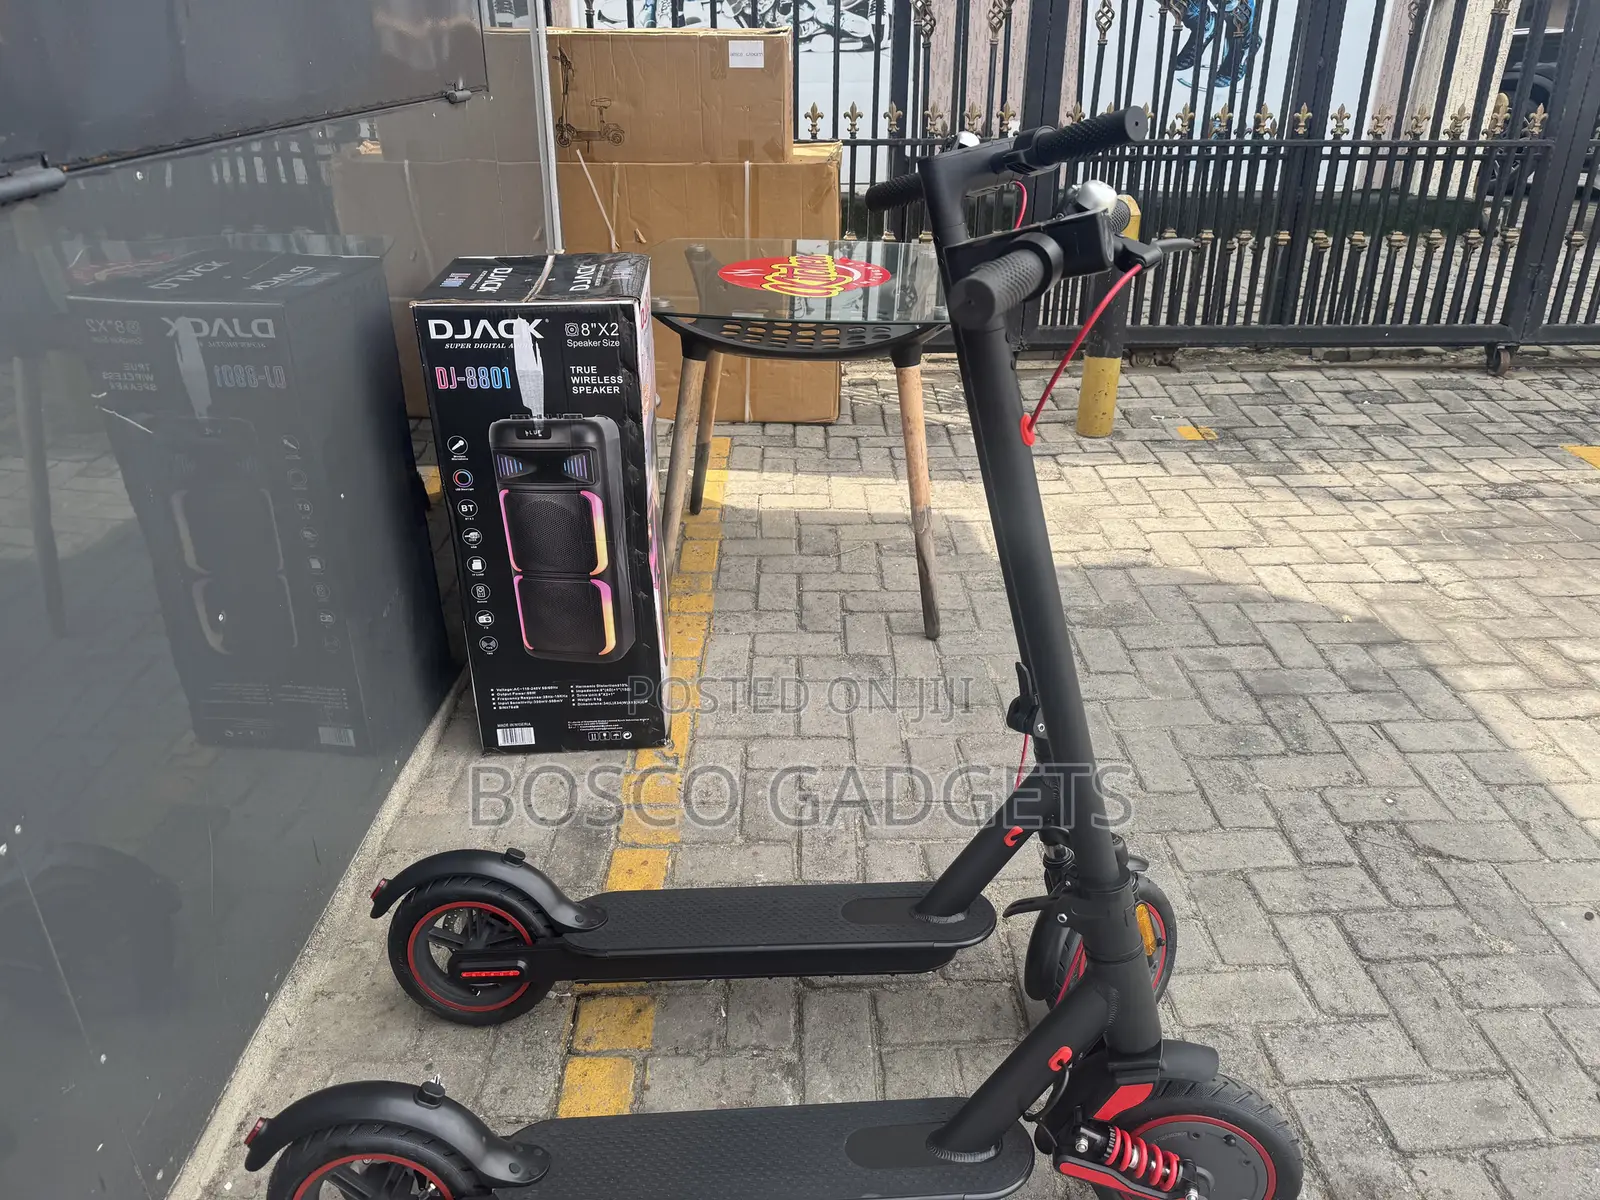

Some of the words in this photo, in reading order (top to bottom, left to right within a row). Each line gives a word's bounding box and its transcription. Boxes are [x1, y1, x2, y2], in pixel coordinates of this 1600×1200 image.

[581, 322, 620, 336] 8"X2
[567, 338, 601, 348] Speaker
[602, 338, 620, 347] Size
[569, 365, 597, 374] TRUE
[435, 366, 511, 389] DJ-8801
[571, 375, 623, 384] WIRELESS
[572, 386, 620, 394] SPEAKER
[460, 504, 474, 512] BT
